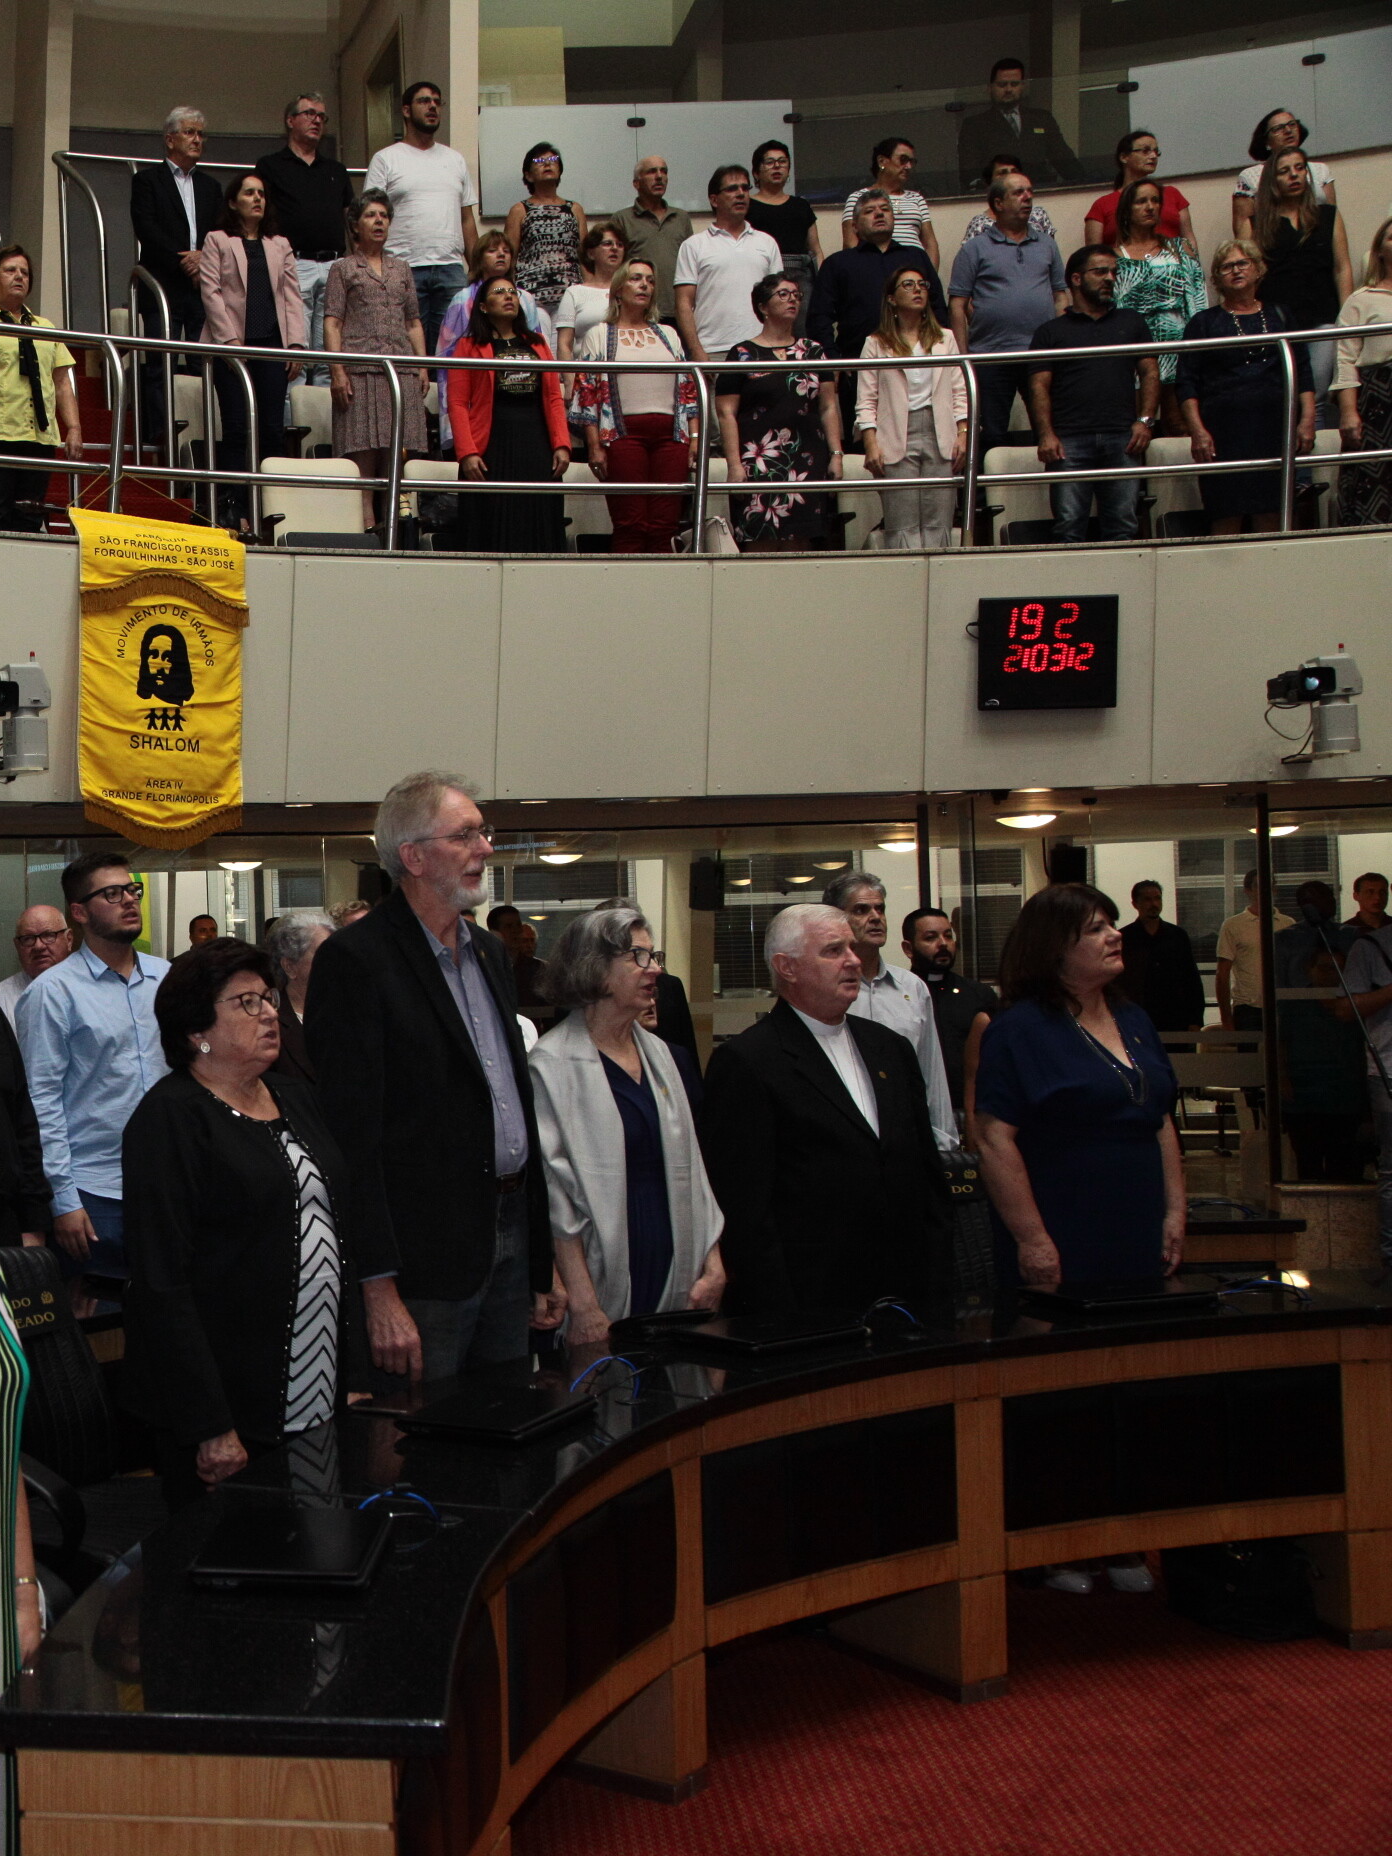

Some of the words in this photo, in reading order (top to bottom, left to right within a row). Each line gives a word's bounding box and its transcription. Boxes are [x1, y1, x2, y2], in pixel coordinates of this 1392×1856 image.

[99, 536, 121, 546] SÃO
[123, 538, 182, 553] FRANCISCO
[185, 545, 198, 555] DE
[200, 546, 230, 557] ASSIS
[94, 547, 178, 565] FORQUILHINHAS
[186, 556, 207, 568] SÃO
[210, 559, 235, 571] JOSÉ
[1008, 603, 1045, 640] 19
[116, 604, 168, 659] MOVIMENTO
[171, 606, 189, 621] DE
[189, 617, 215, 668] IRMÃOS
[129, 734, 200, 754] SHALOM
[145, 777, 173, 790] ÁREA
[174, 780, 184, 790] IV
[101, 789, 143, 801] GRANDE
[146, 792, 220, 804] FLORIANÓPOLIS
